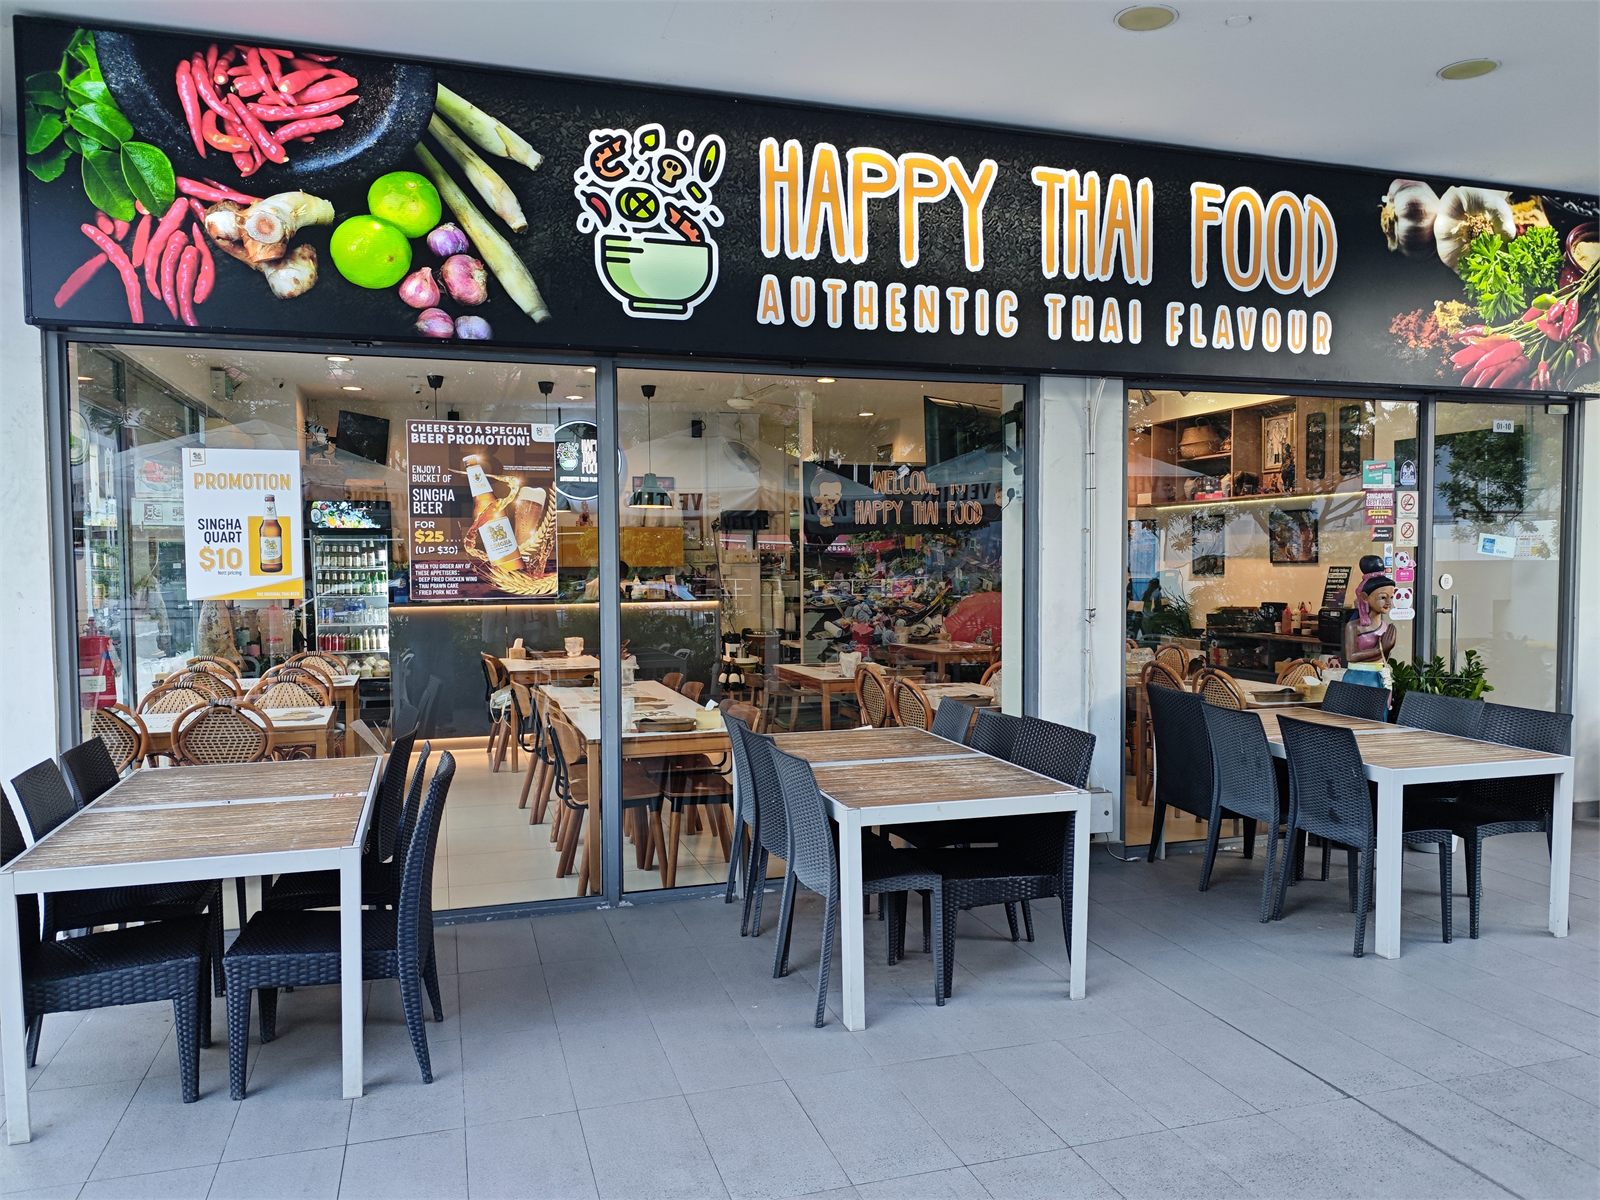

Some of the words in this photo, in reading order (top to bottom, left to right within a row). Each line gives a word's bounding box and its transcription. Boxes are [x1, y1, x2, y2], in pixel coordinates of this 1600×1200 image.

[760, 137, 998, 272] HAPPY
[1031, 166, 1153, 286] THAI
[1190, 181, 1338, 297] FOOD
[757, 274, 1018, 338] AUTHENTIC
[1044, 294, 1142, 344] THAI
[1166, 302, 1332, 355] FLAVOUR
[411, 423, 454, 433] CHEERS
[458, 425, 472, 433] TO
[475, 426, 482, 434] A
[485, 426, 530, 436] SPECIAL
[1496, 422, 1512, 430] 01-10
[411, 433, 444, 444] BEER
[447, 434, 530, 446] PROMOTION!
[412, 465, 436, 474] ENJOY
[437, 465, 441, 473] 1
[582, 463, 597, 474] FOO
[193, 472, 291, 491] PROMOTION
[412, 474, 440, 483] BUCKET
[442, 474, 452, 483] OF
[412, 488, 455, 502] SINGHA
[413, 501, 443, 515] BEER
[855, 500, 903, 525] HAPPY
[911, 500, 939, 525] THAI
[197, 518, 242, 531] SINGHA
[414, 521, 435, 529] FOR
[203, 531, 242, 544] QUART
[414, 529, 445, 544] $25
[415, 545, 435, 555] (U.P
[437, 545, 458, 555] $30)
[199, 546, 243, 572] $10
